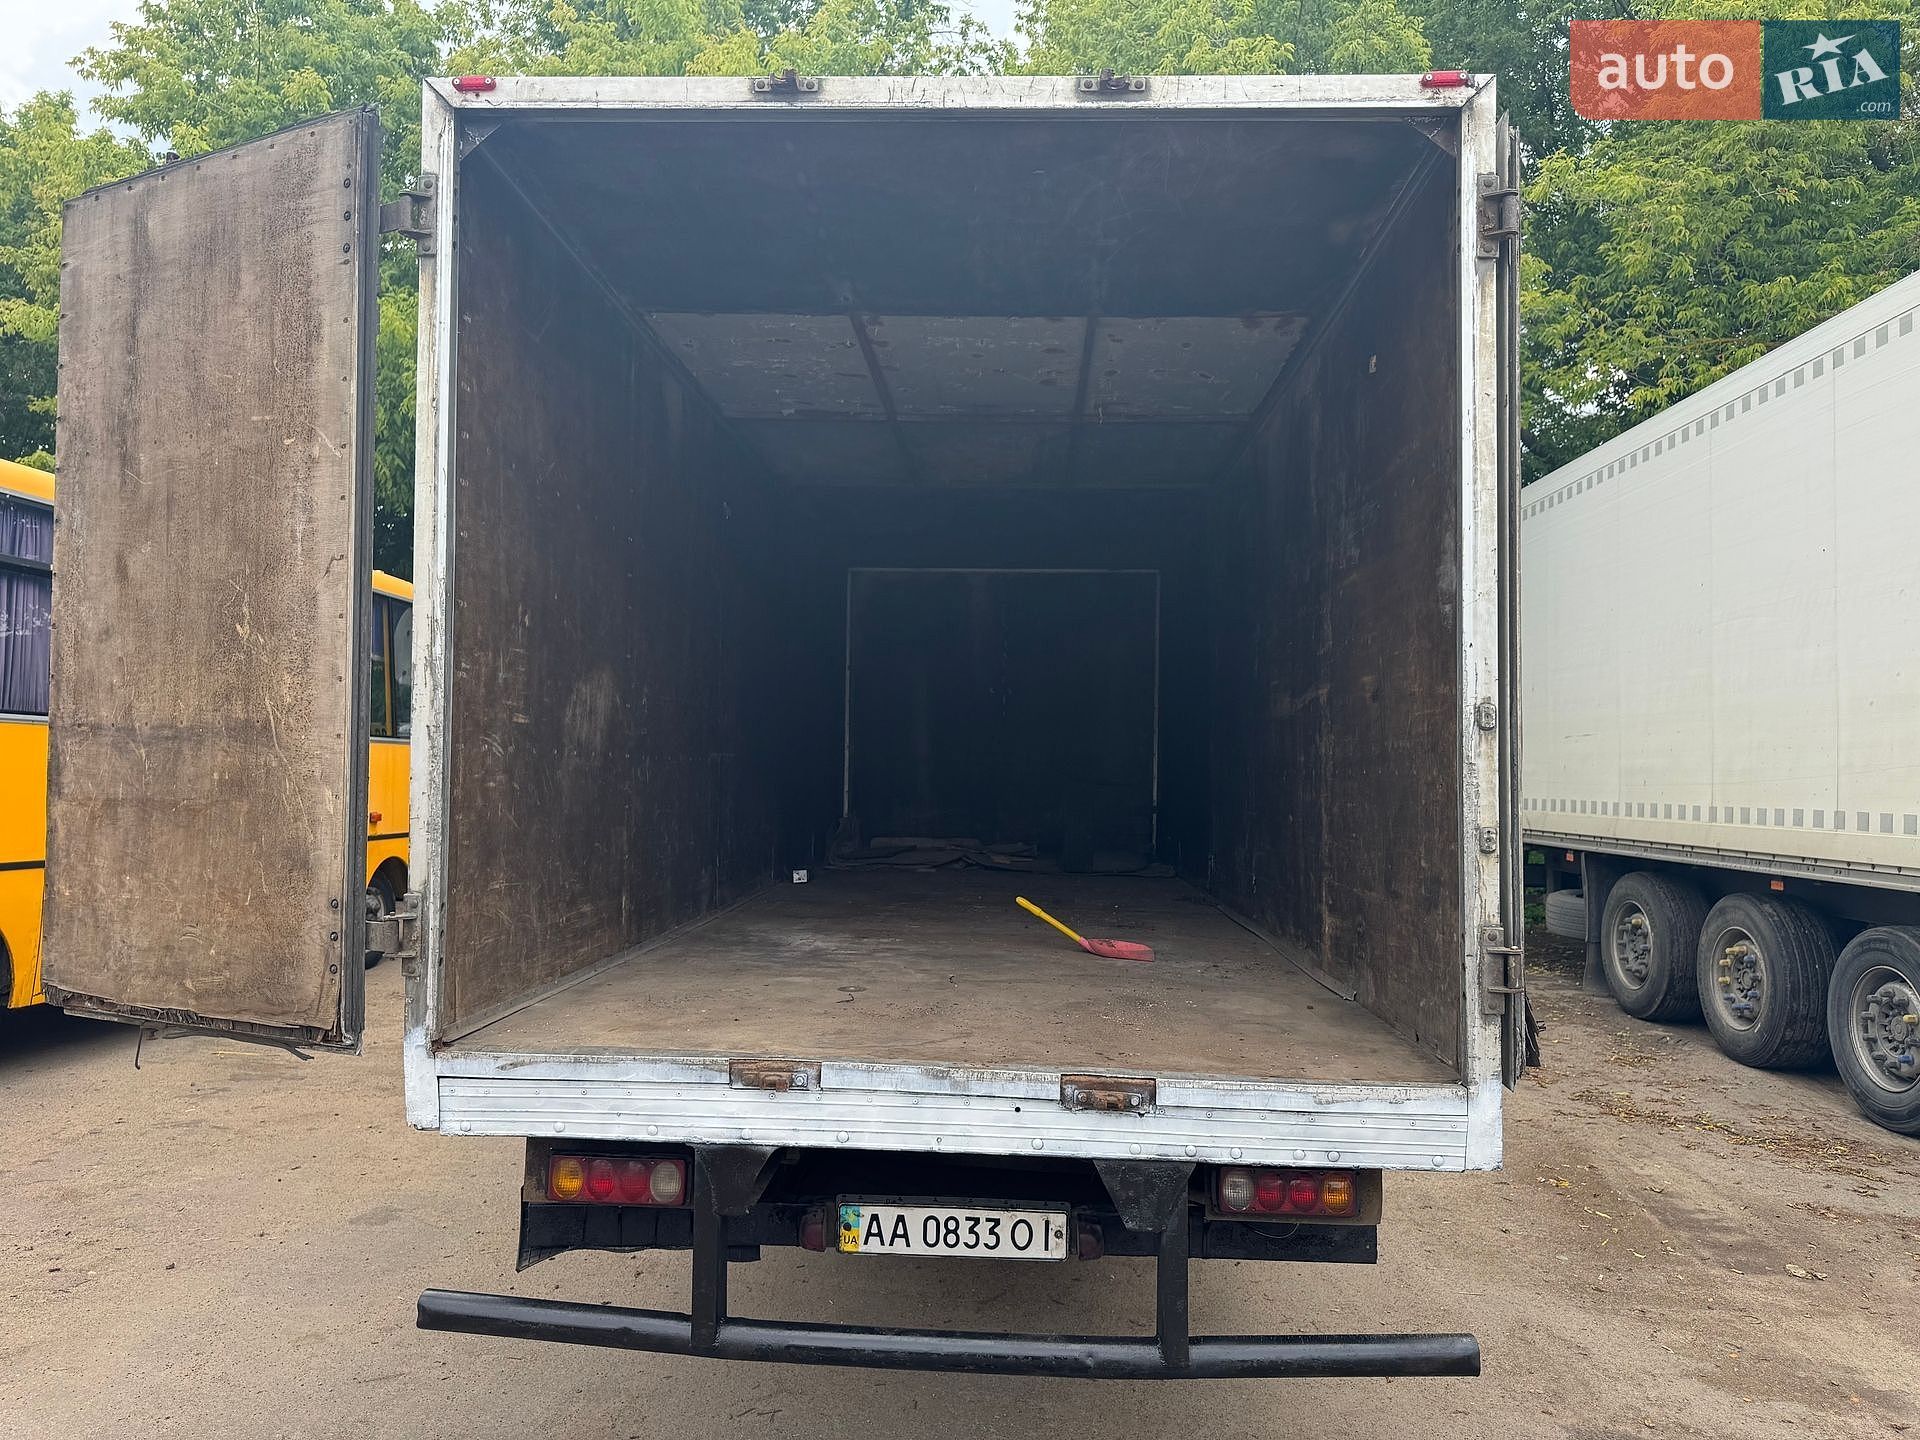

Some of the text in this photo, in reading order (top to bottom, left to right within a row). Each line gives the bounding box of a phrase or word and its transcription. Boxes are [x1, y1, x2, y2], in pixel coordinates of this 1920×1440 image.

[843, 1235, 858, 1245] UA
[863, 1213, 911, 1247] AA
[922, 1215, 1001, 1250] 0833
